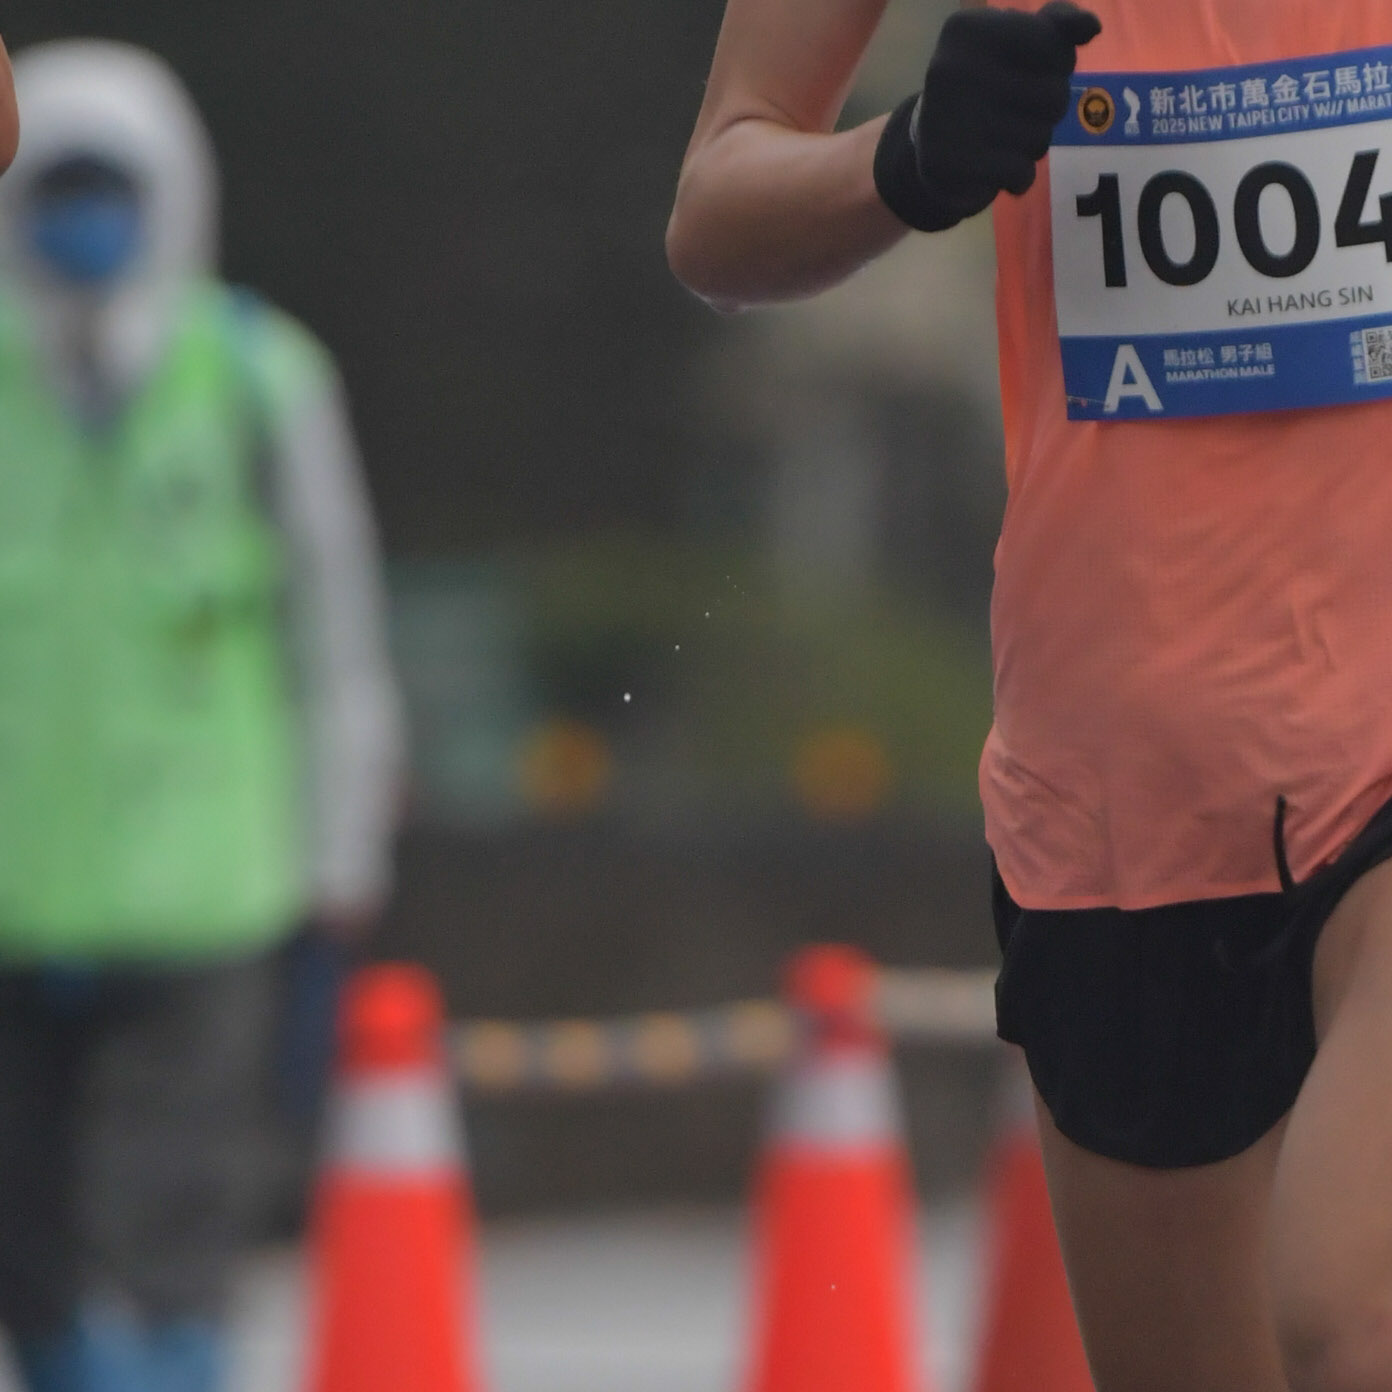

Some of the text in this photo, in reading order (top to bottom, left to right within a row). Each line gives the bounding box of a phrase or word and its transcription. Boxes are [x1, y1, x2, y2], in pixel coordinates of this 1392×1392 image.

[1152, 117, 1186, 134] 2025
[1188, 114, 1223, 133] NEW
[1228, 108, 1275, 129] TAIPEI
[1278, 104, 1310, 123] CITY
[1227, 284, 1374, 316] KAI HANG SIN
[1163, 342, 1274, 366] 馬拉松 男子組
[1103, 344, 1164, 413] A
[1165, 363, 1276, 383] MARATHON MALE
